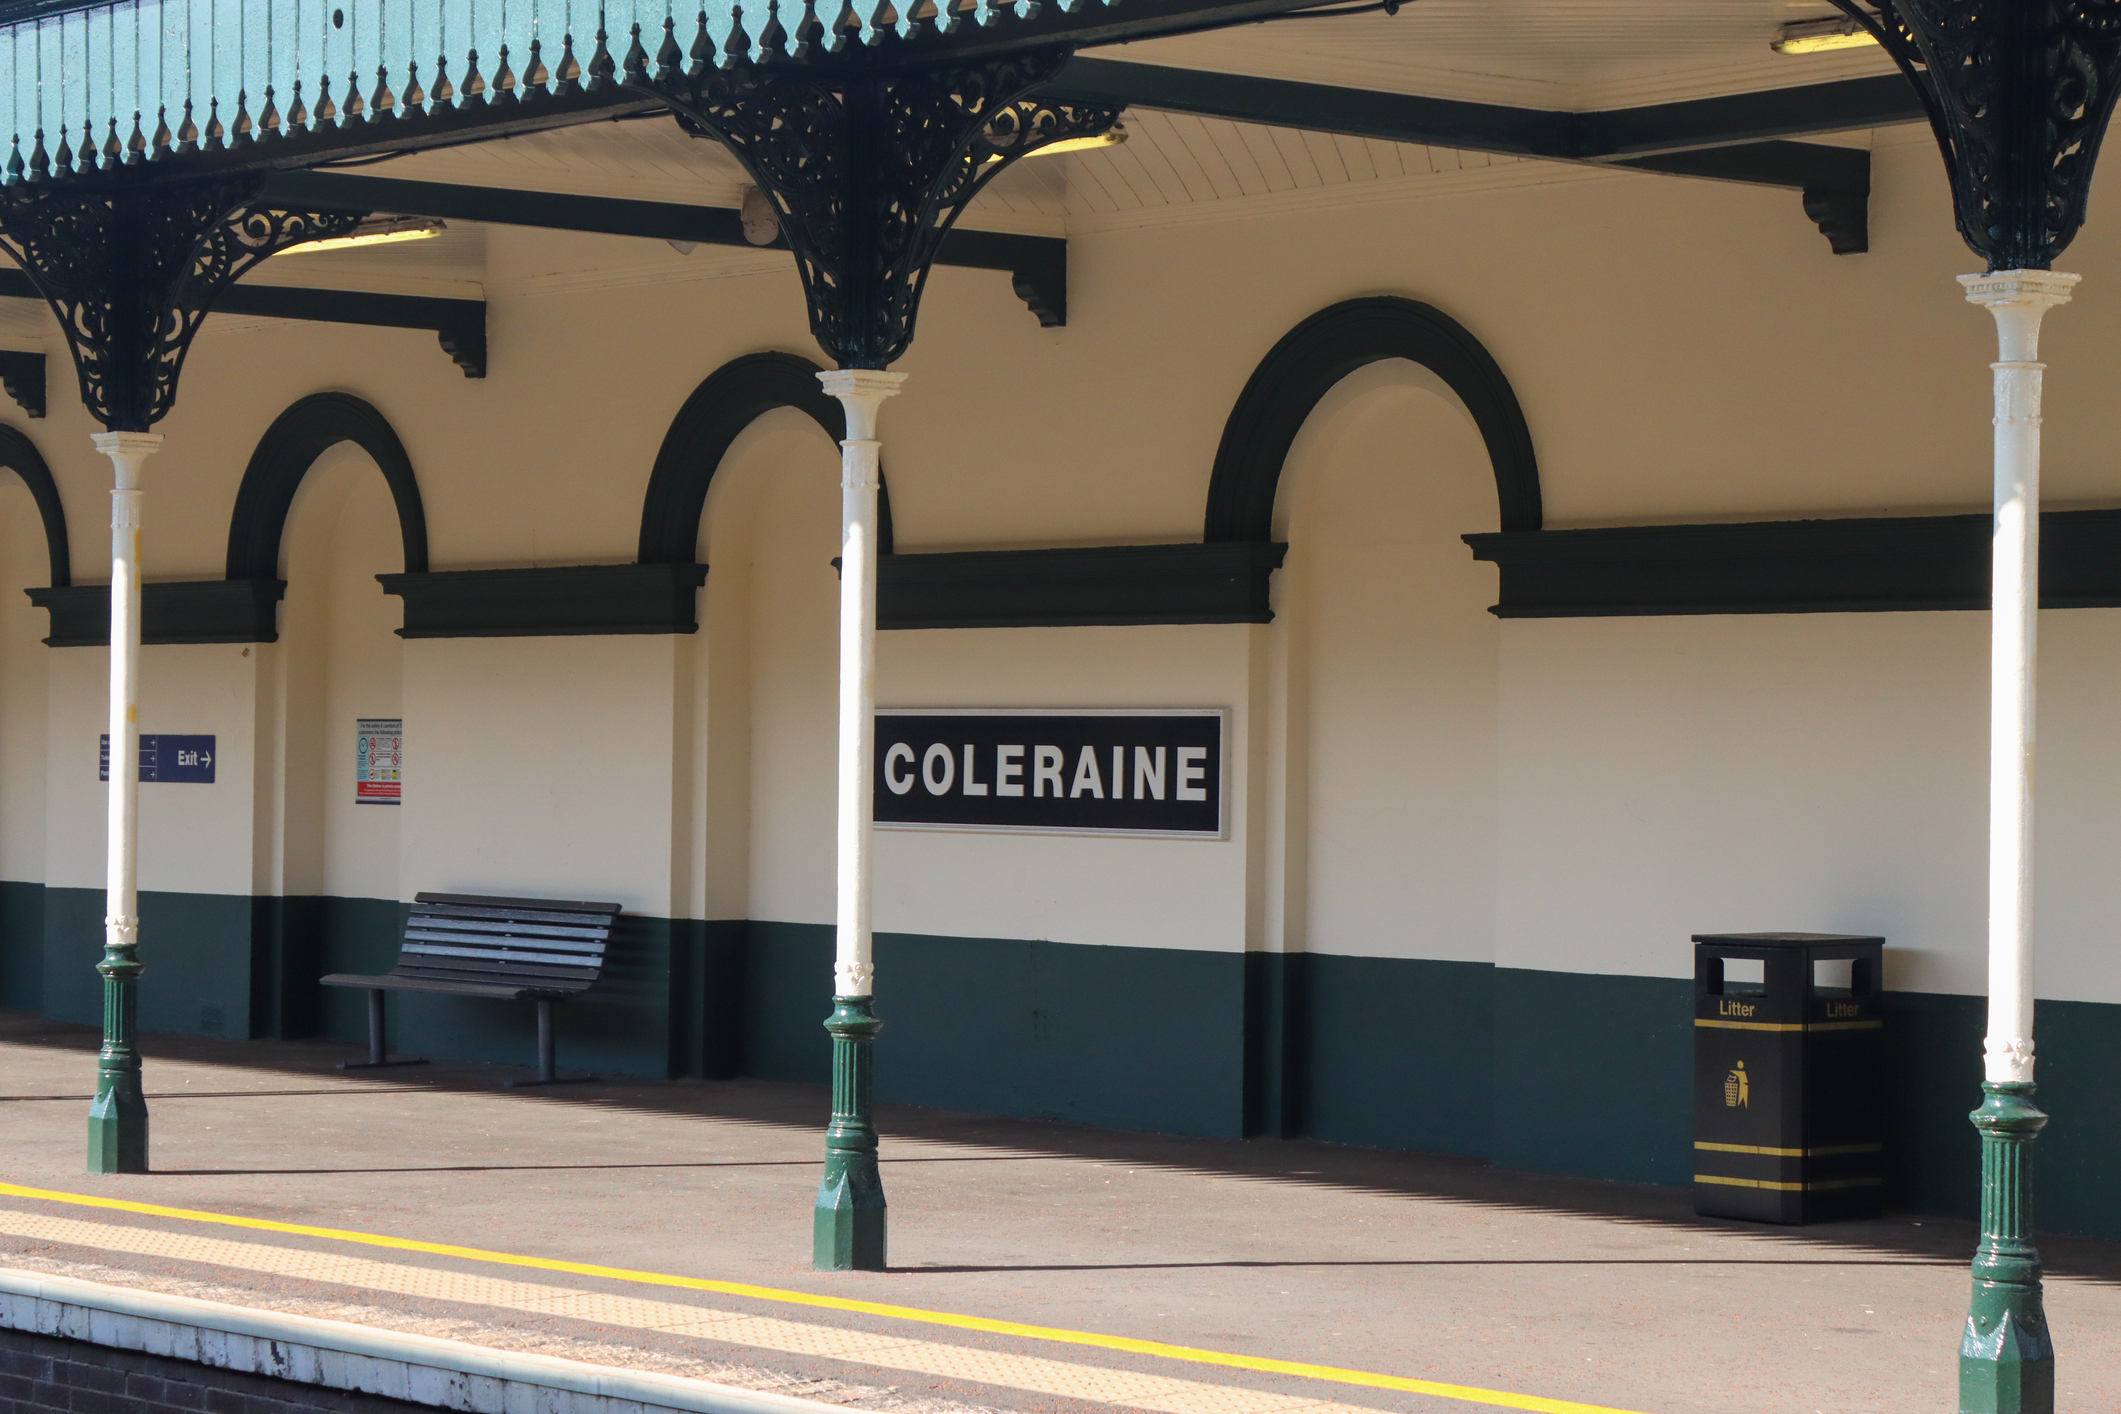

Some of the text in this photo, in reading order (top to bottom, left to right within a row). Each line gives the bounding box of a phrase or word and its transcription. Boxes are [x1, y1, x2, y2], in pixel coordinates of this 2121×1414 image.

[178, 750, 198, 766] Exit
[884, 742, 1207, 801] COLERAINE
[1720, 1000, 1755, 1017] Litter
[1827, 1003, 1860, 1017] Litter
